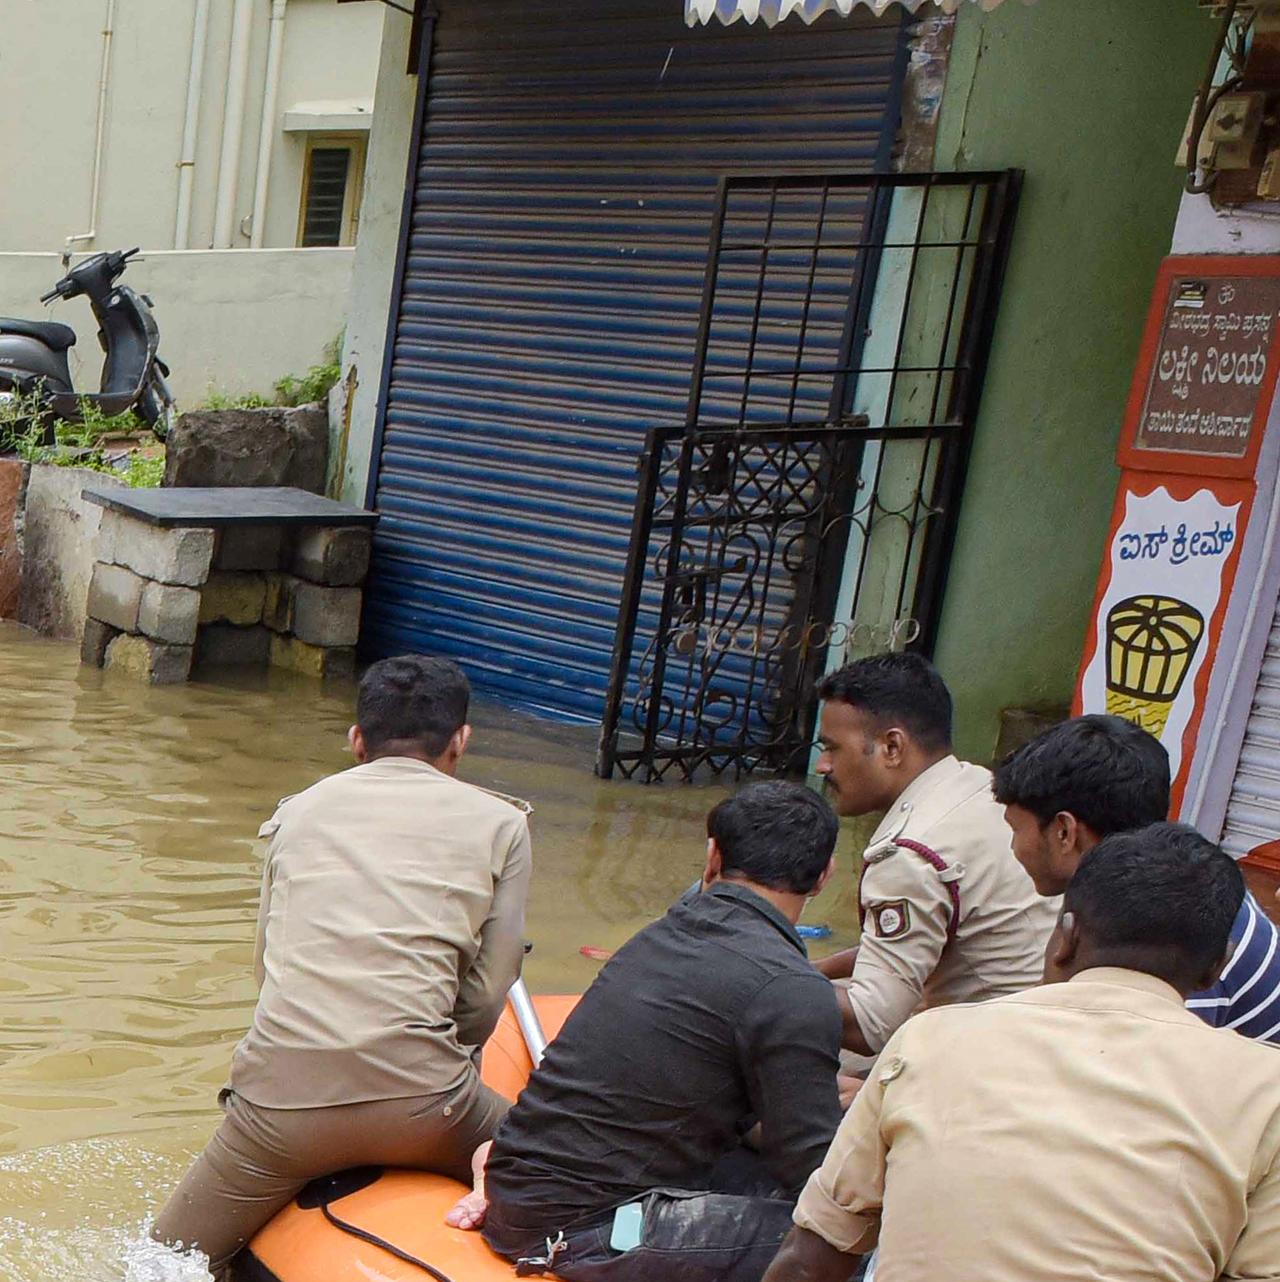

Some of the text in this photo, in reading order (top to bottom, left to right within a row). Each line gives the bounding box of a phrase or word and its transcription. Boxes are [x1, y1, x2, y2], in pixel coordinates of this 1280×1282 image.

[1202, 345, 1266, 385] ನಿಲಯ
[1119, 520, 1234, 565] ಐಸ್ ಕ್ರೀಮ್
